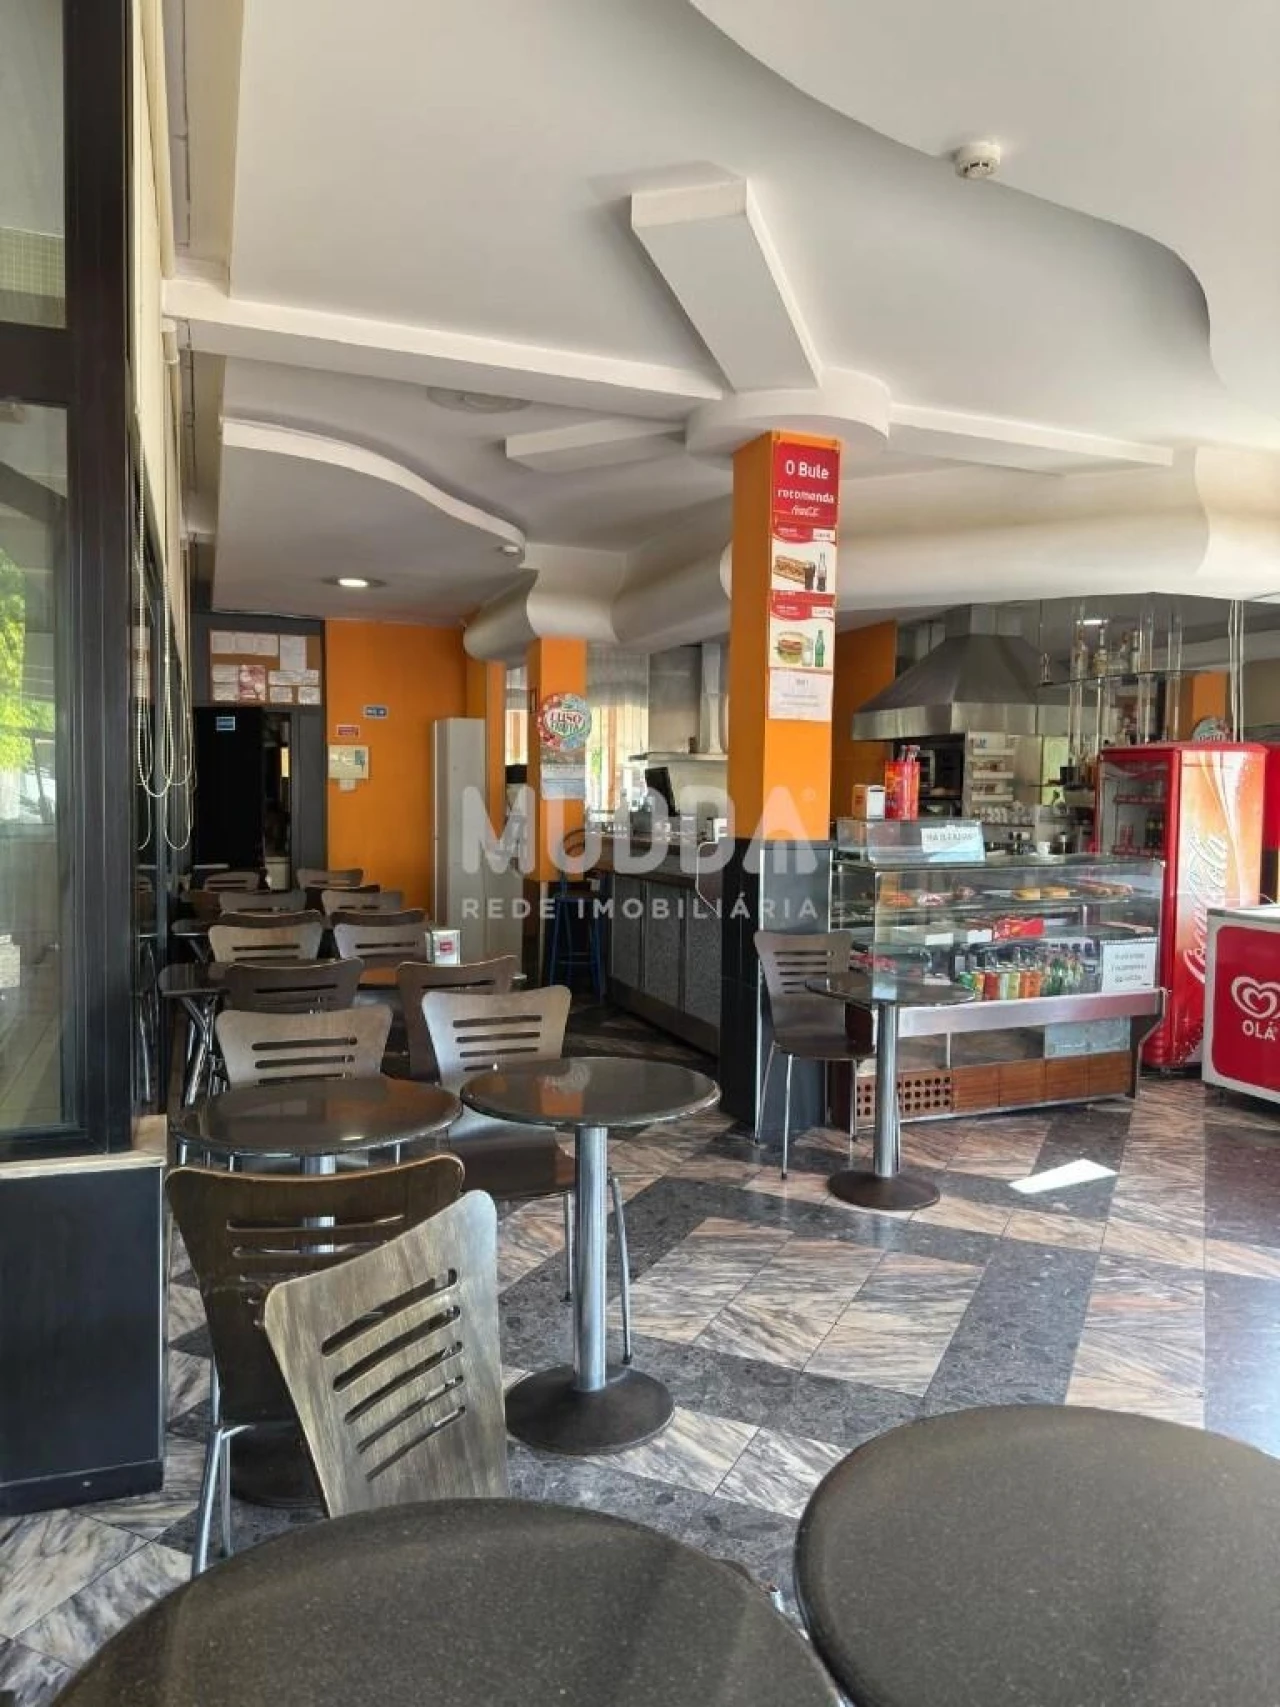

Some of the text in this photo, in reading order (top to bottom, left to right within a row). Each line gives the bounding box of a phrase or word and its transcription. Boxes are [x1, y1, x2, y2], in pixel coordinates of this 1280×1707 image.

[785, 459, 830, 480] O Bule
[1242, 1019, 1276, 1041] OLÁ
